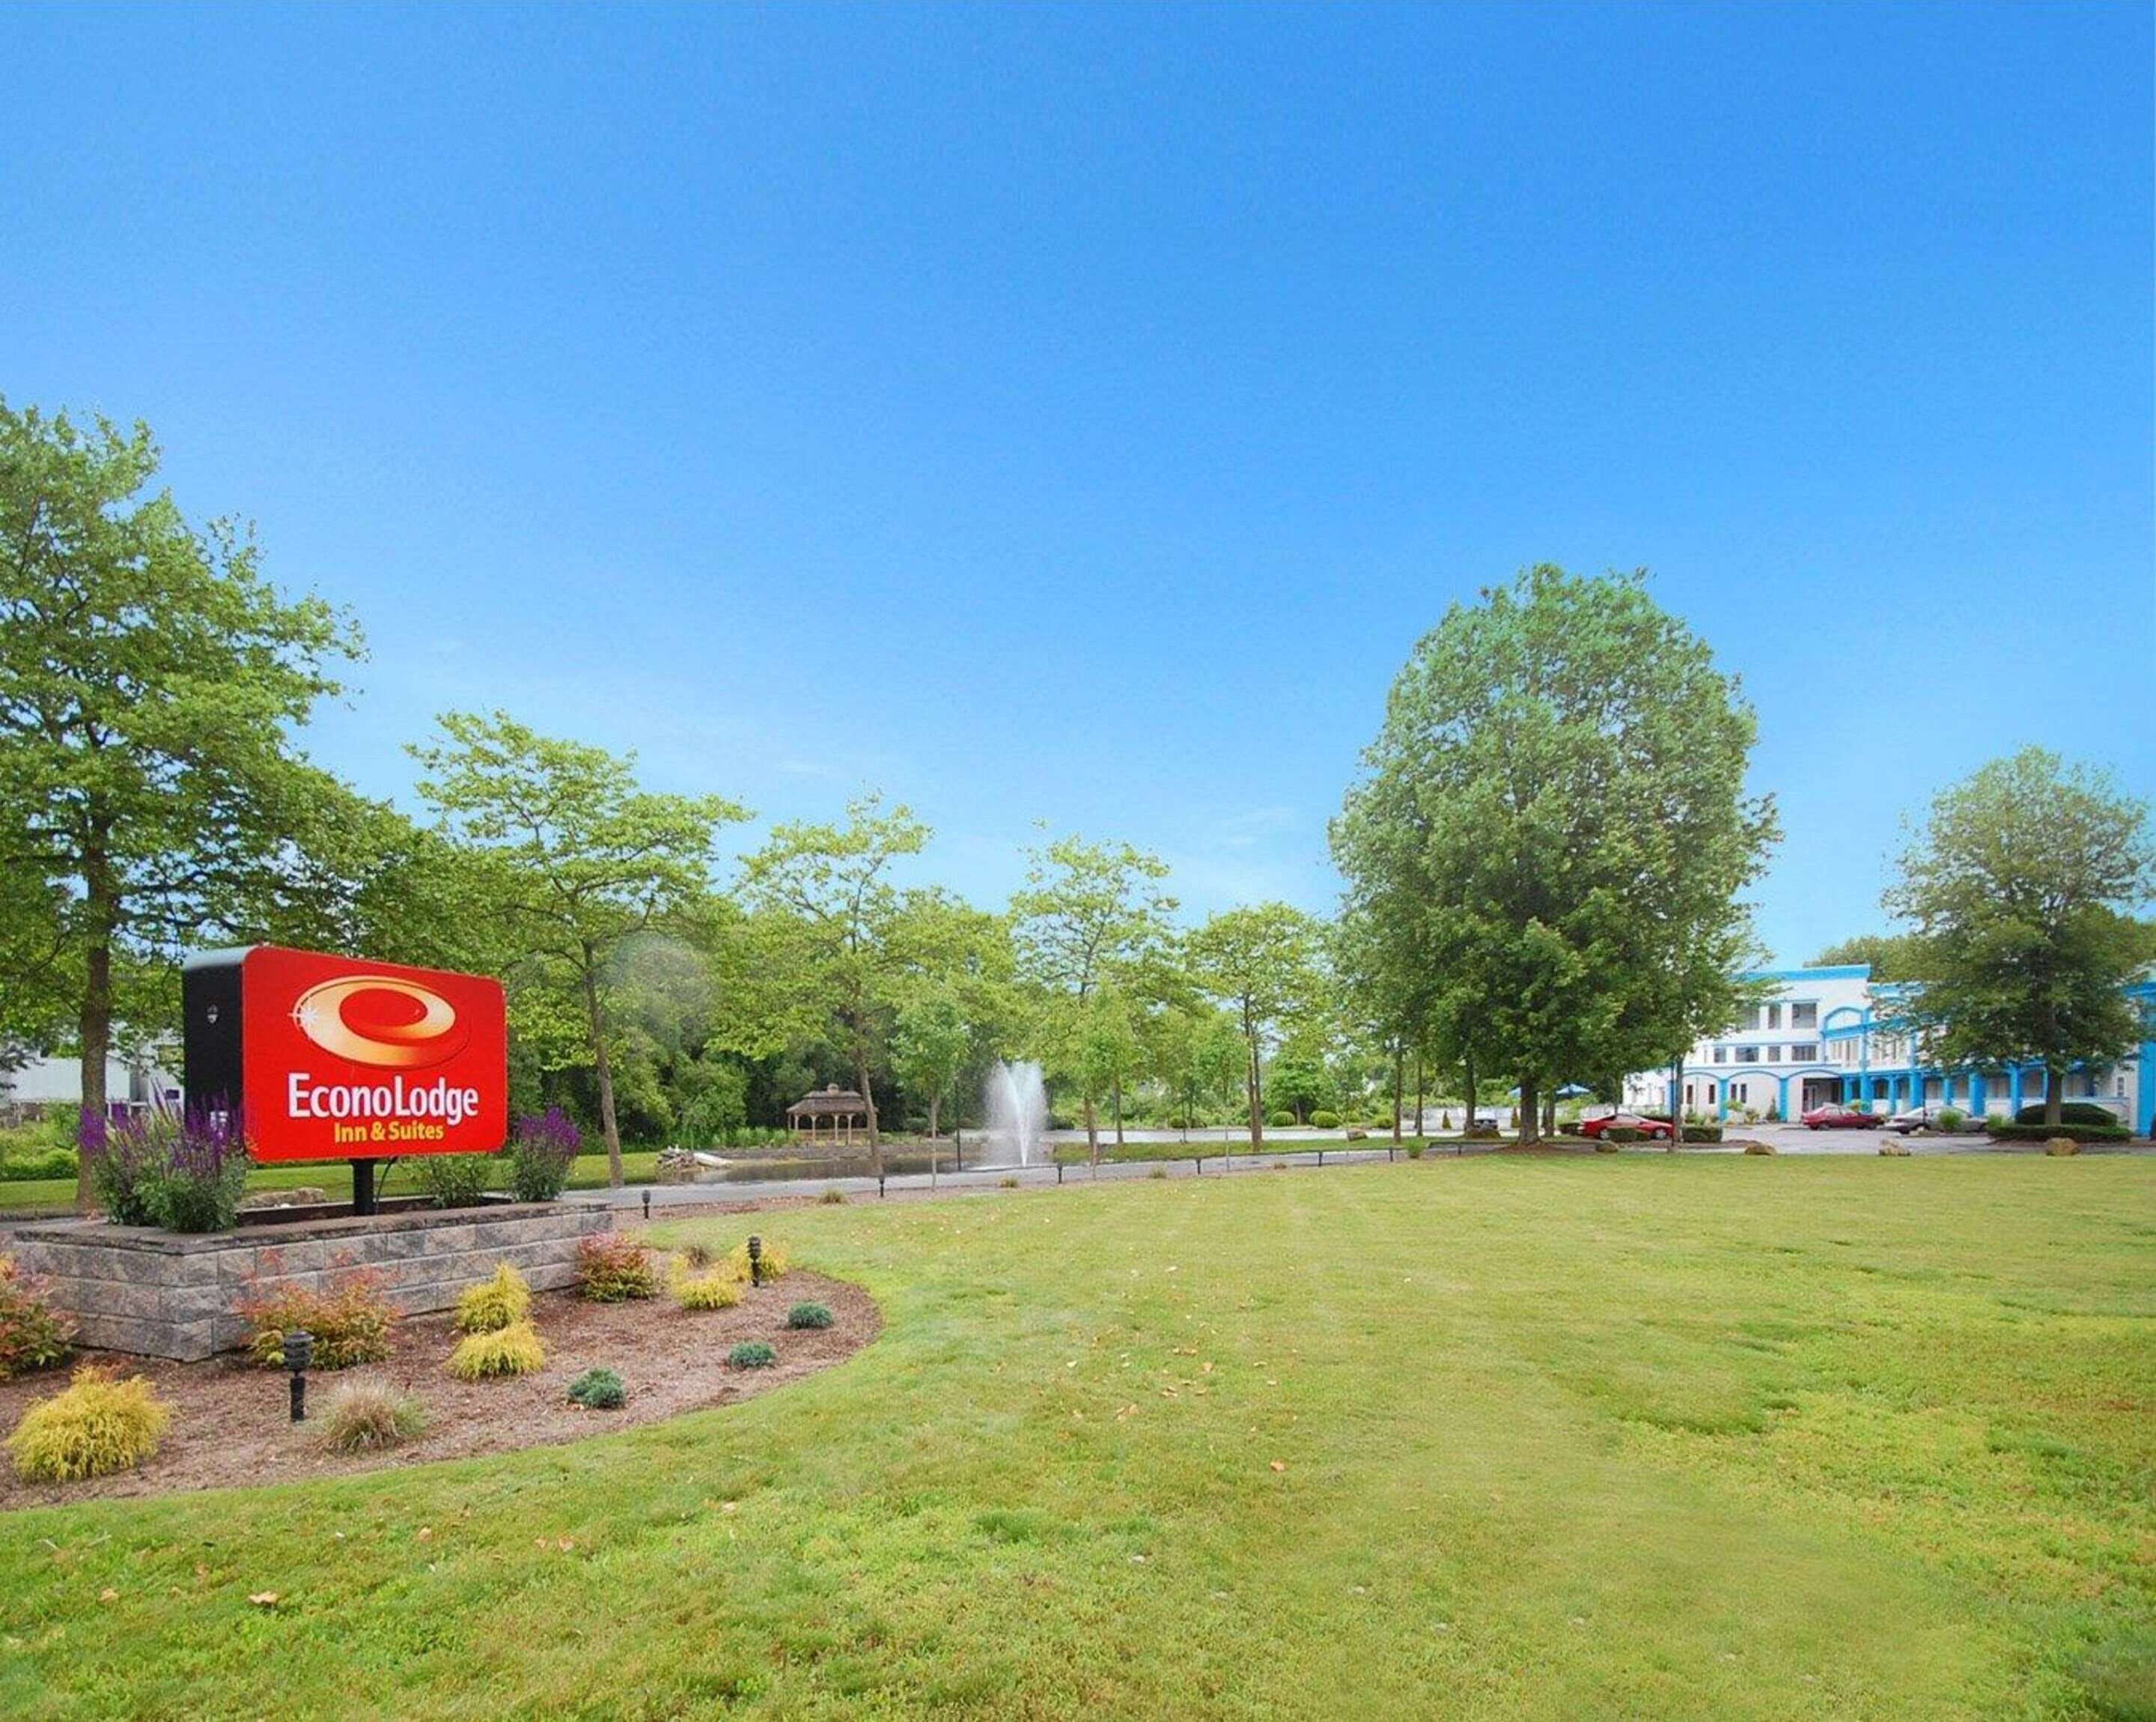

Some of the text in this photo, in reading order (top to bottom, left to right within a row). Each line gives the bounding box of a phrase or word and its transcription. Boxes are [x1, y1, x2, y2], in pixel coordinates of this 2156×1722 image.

[288, 1072, 479, 1126] EconoLodge
[334, 1119, 445, 1143] Inn & Suites
